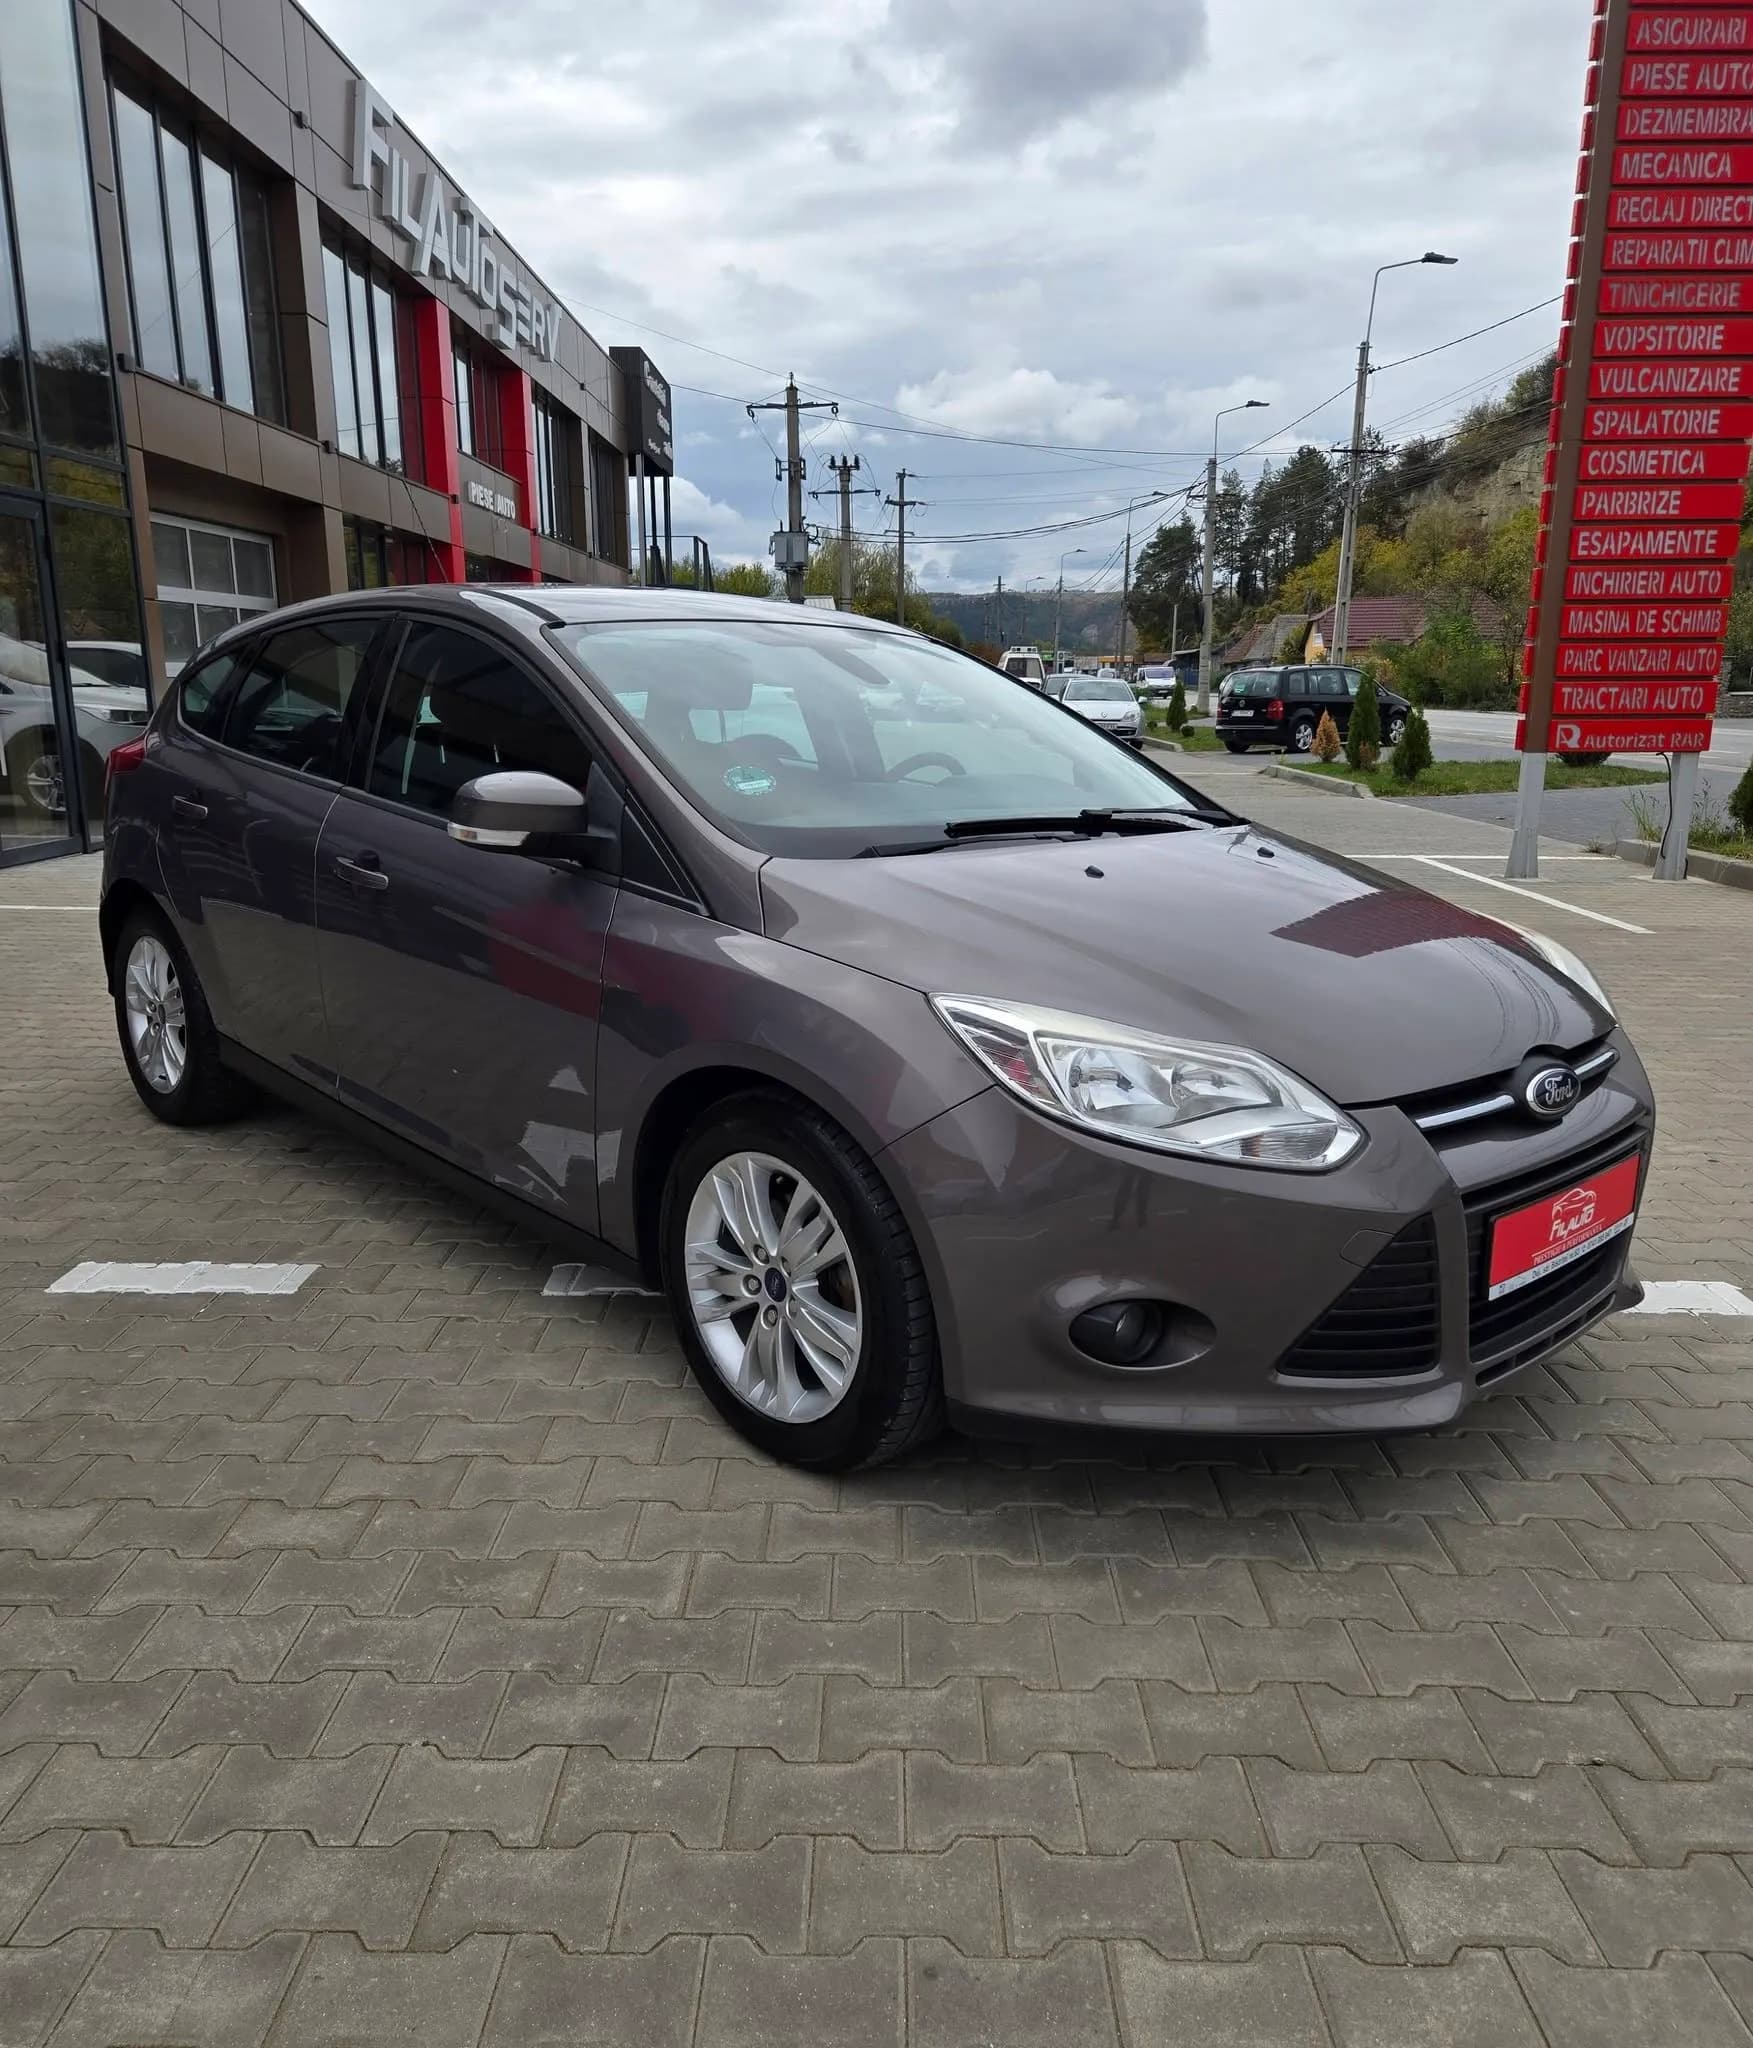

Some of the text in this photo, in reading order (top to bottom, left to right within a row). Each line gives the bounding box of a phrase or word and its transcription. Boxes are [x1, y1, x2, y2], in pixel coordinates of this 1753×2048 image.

[1636, 17, 1747, 45] ASIGURARI
[1630, 63, 1690, 90] PIESE
[1621, 151, 1732, 179] MECANICA
[1616, 196, 1685, 223] REGLAJ
[1611, 239, 1708, 266] REPARATII
[1608, 281, 1743, 308] TINICHIGERIE
[1603, 324, 1726, 351] VOPSITORIE
[1600, 366, 1742, 393] VULCANIZARE
[1592, 409, 1721, 436] SPALATORIE
[1587, 449, 1706, 476] COSMETICA
[468, 481, 516, 520] PIESE AUTO
[1581, 490, 1682, 516] PARBRIZE
[1577, 529, 1718, 556] ESAPAMENTE
[1572, 570, 1722, 595] INCHIRIERI AUTO
[1568, 609, 1722, 634] MASINA DE SCHIMB
[1564, 648, 1718, 673] PARC VANZARI AUTO
[1562, 686, 1704, 711] TRACTARI AUTO
[1671, 732, 1705, 748] RAR
[1544, 1075, 1574, 1105] Ford
